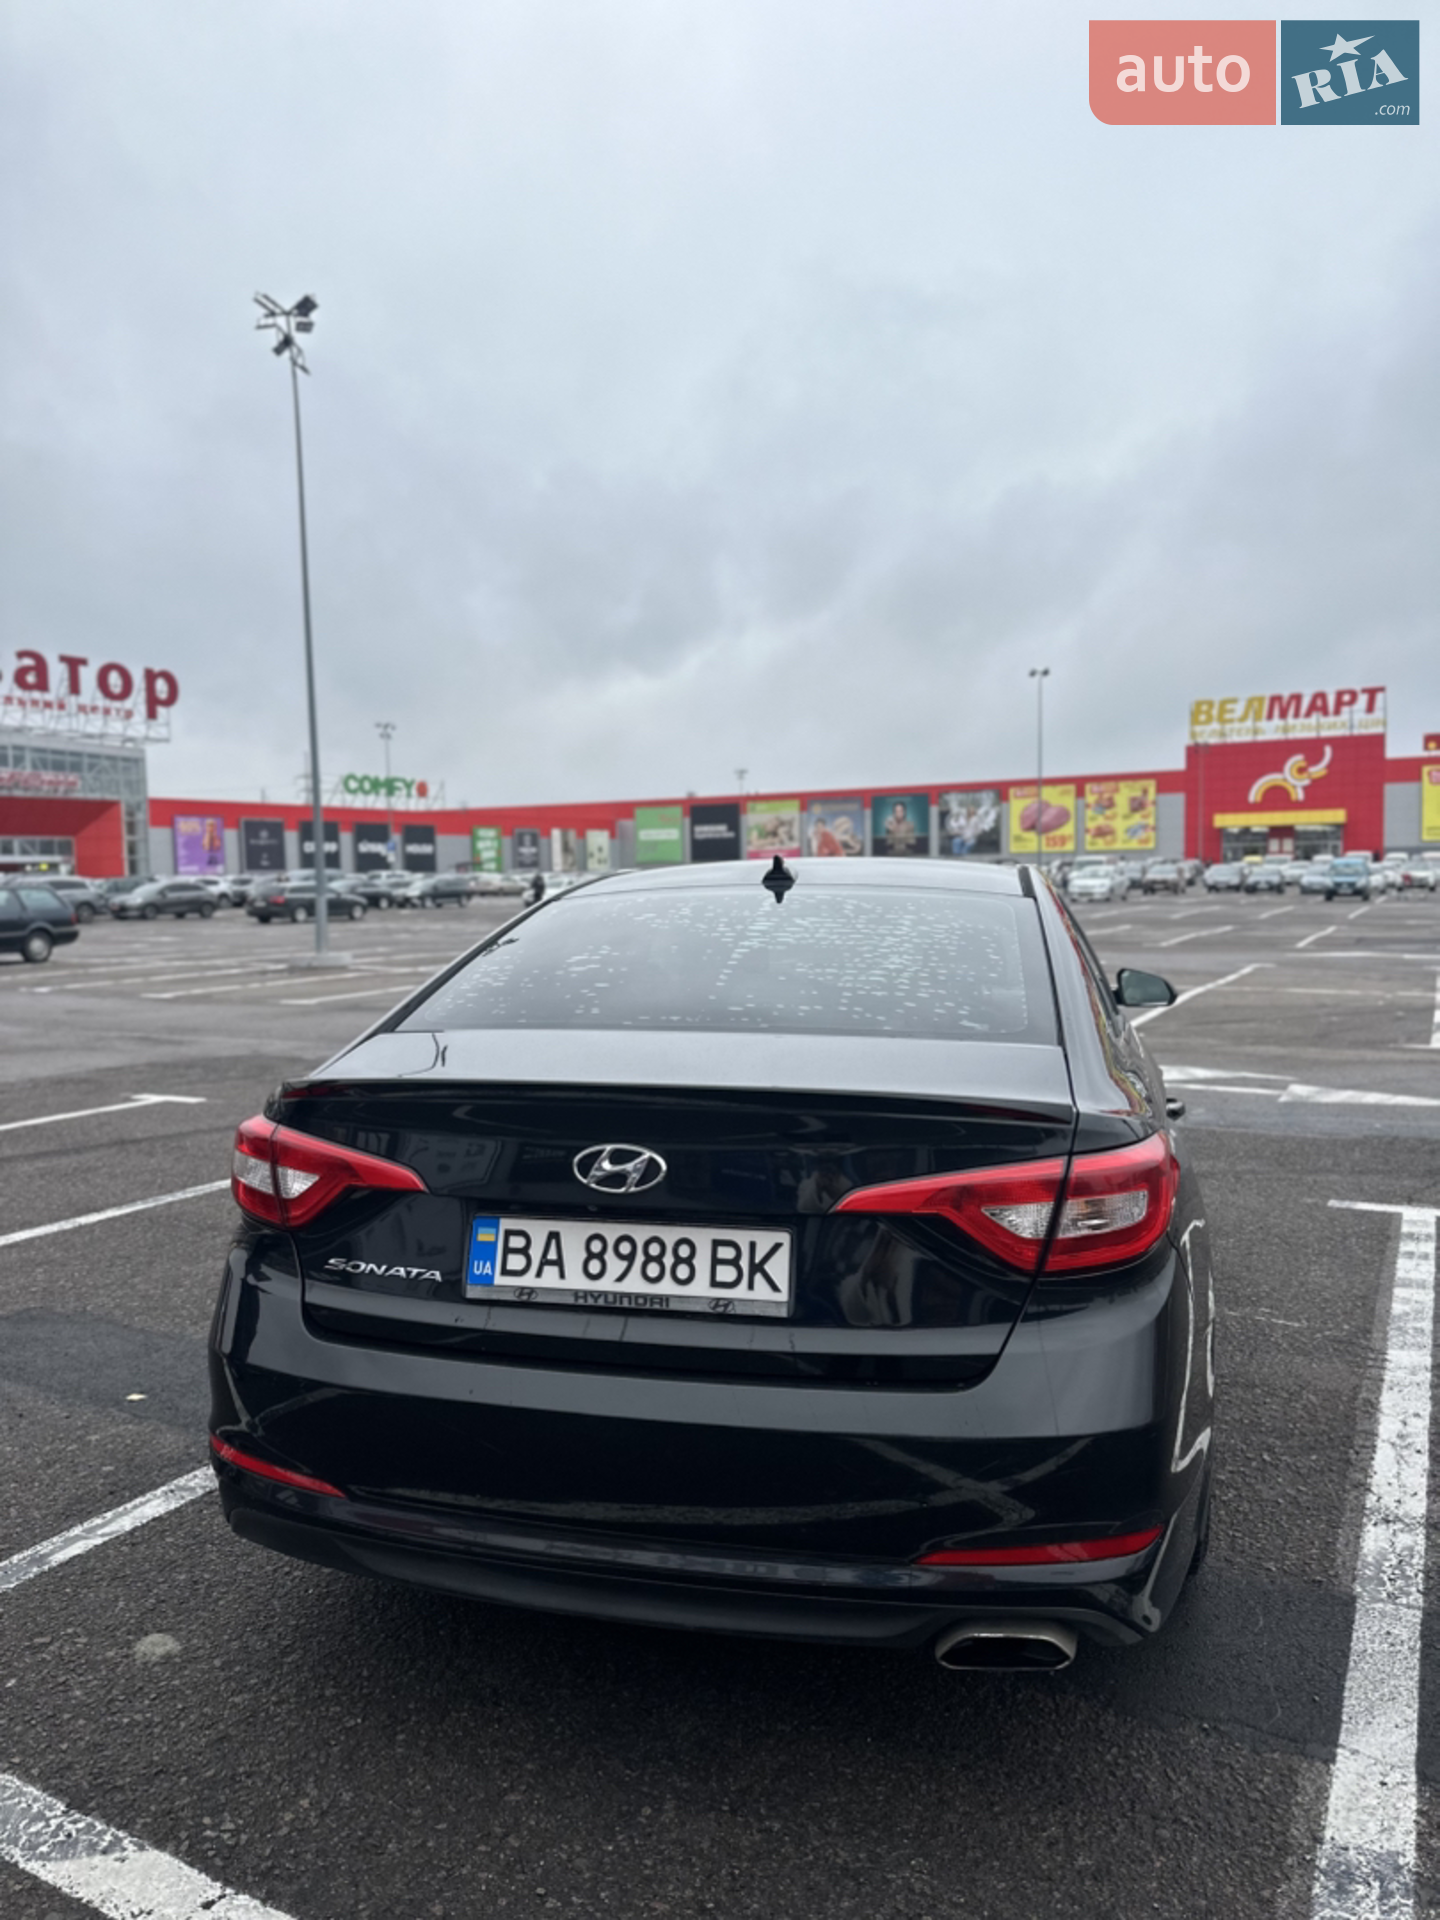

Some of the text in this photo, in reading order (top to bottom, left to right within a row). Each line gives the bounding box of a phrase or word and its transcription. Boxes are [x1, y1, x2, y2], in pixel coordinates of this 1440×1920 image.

[0, 649, 179, 720] атор
[1191, 686, 1385, 726] ВЕЛМАРТ
[343, 773, 416, 798] COMFY
[324, 1257, 443, 1282] SONATA
[473, 1260, 493, 1276] UA
[500, 1228, 785, 1293] BA 8988 BK
[573, 1291, 670, 1308] HYUNDAI
